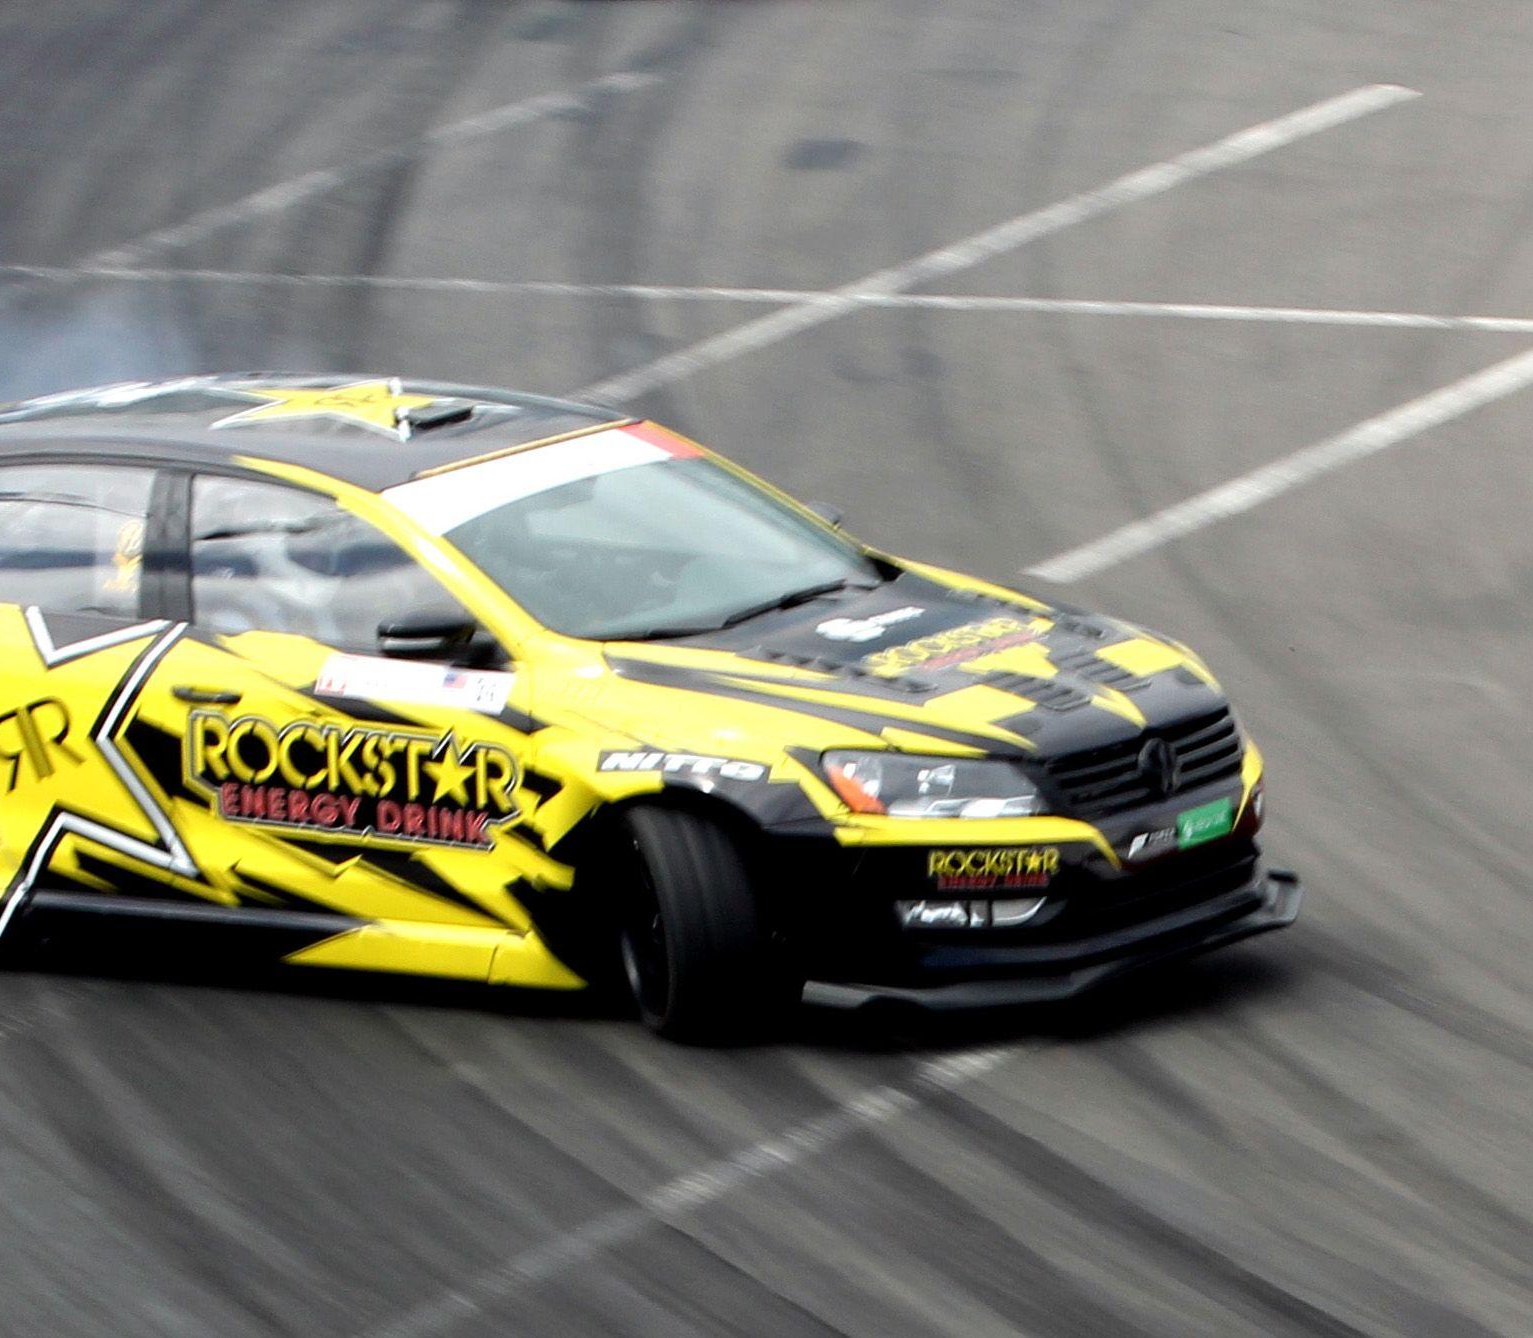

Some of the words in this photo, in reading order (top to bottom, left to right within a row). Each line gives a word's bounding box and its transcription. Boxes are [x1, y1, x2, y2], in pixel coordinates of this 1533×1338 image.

[601, 752, 765, 781] NITTO
[222, 782, 363, 826] ENERGY
[377, 800, 489, 843] DRINK
